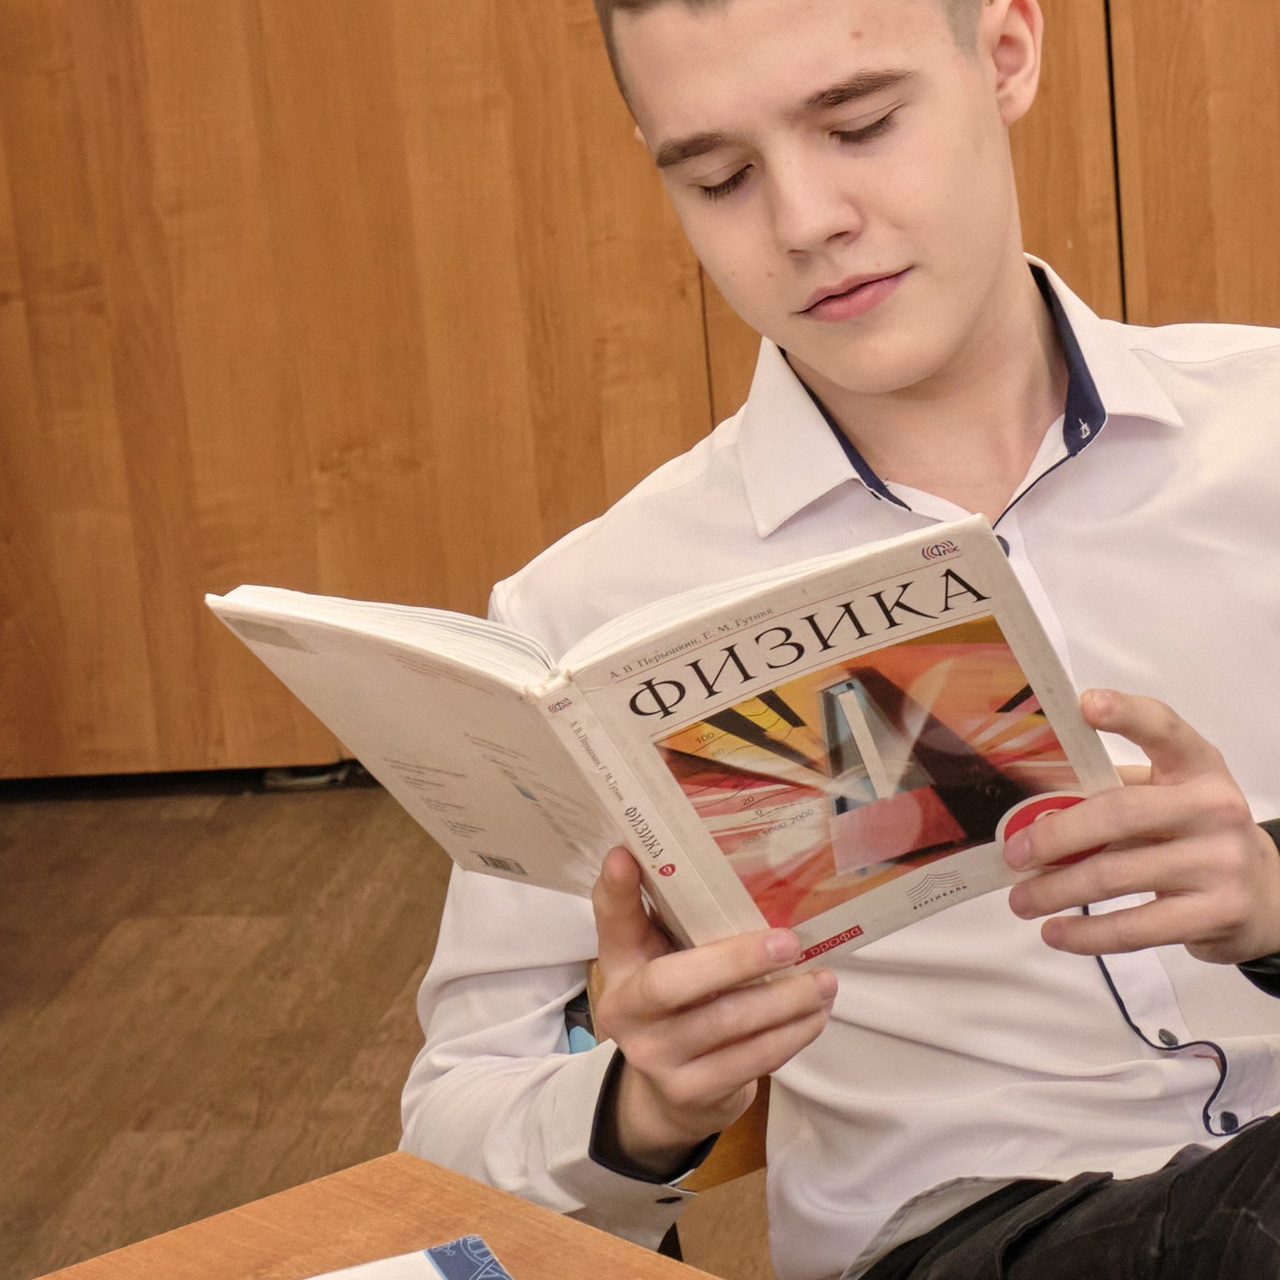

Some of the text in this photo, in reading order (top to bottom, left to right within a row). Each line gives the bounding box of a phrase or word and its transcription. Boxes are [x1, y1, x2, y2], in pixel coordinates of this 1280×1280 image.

[629, 567, 992, 720] ФИЗИКА
[696, 731, 716, 745] 100
[741, 795, 755, 806] 20
[624, 806, 664, 859] ФИЗИКА
